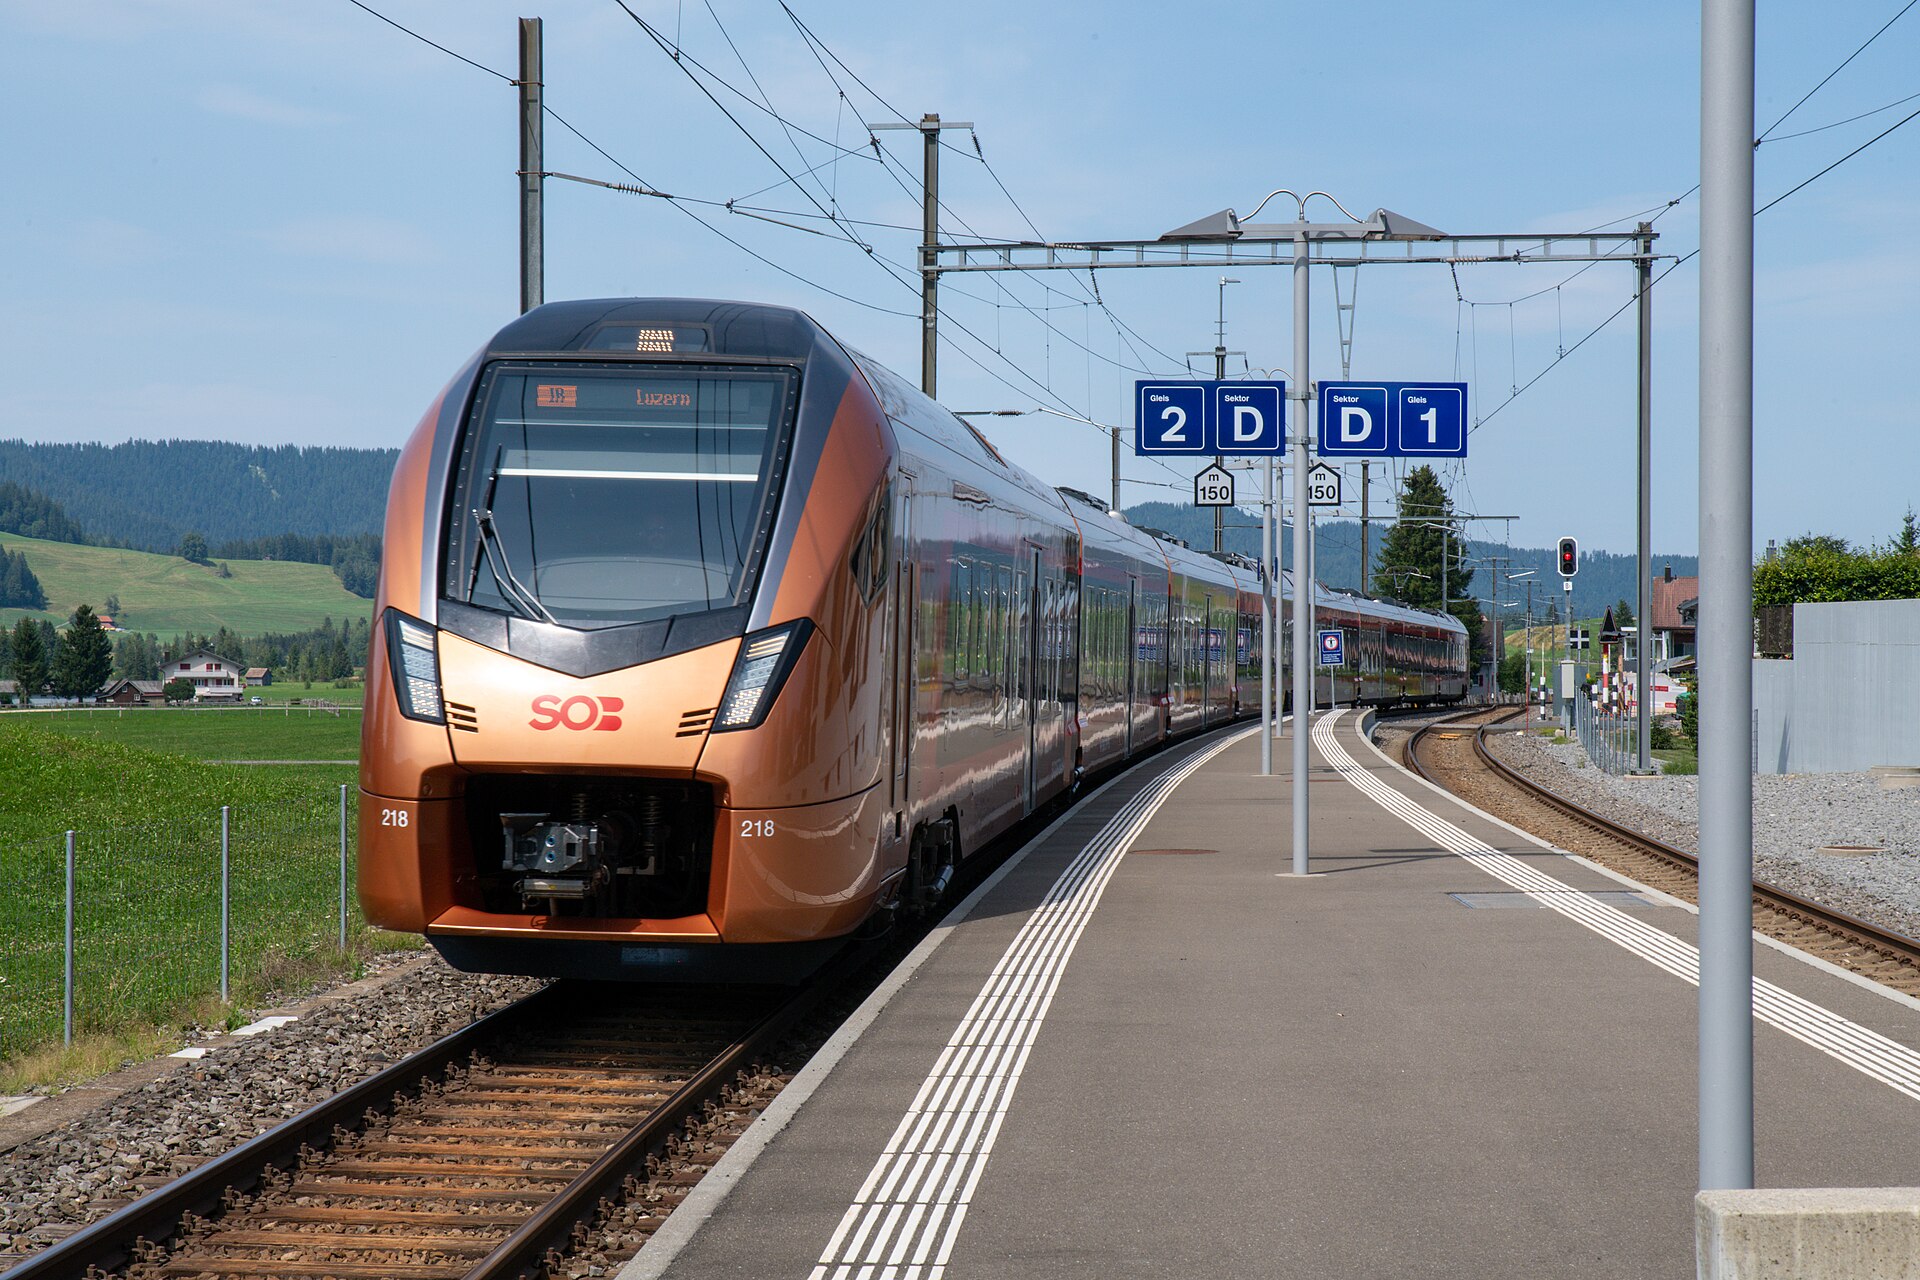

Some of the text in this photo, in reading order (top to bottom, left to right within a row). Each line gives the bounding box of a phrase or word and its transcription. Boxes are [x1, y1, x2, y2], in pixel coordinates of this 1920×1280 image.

[636, 388, 691, 406] Luzern
[1333, 395, 1359, 403] Sektor
[1407, 396, 1427, 404] Gleis
[1161, 406, 1187, 442] 2
[1233, 406, 1264, 442] D
[1341, 407, 1373, 442] D
[1420, 407, 1437, 443] 1
[1208, 473, 1220, 481] m
[1314, 473, 1326, 481] m
[1199, 485, 1230, 500] 150
[528, 694, 624, 731] SOB
[381, 808, 409, 828] 218
[740, 819, 775, 837] 218
